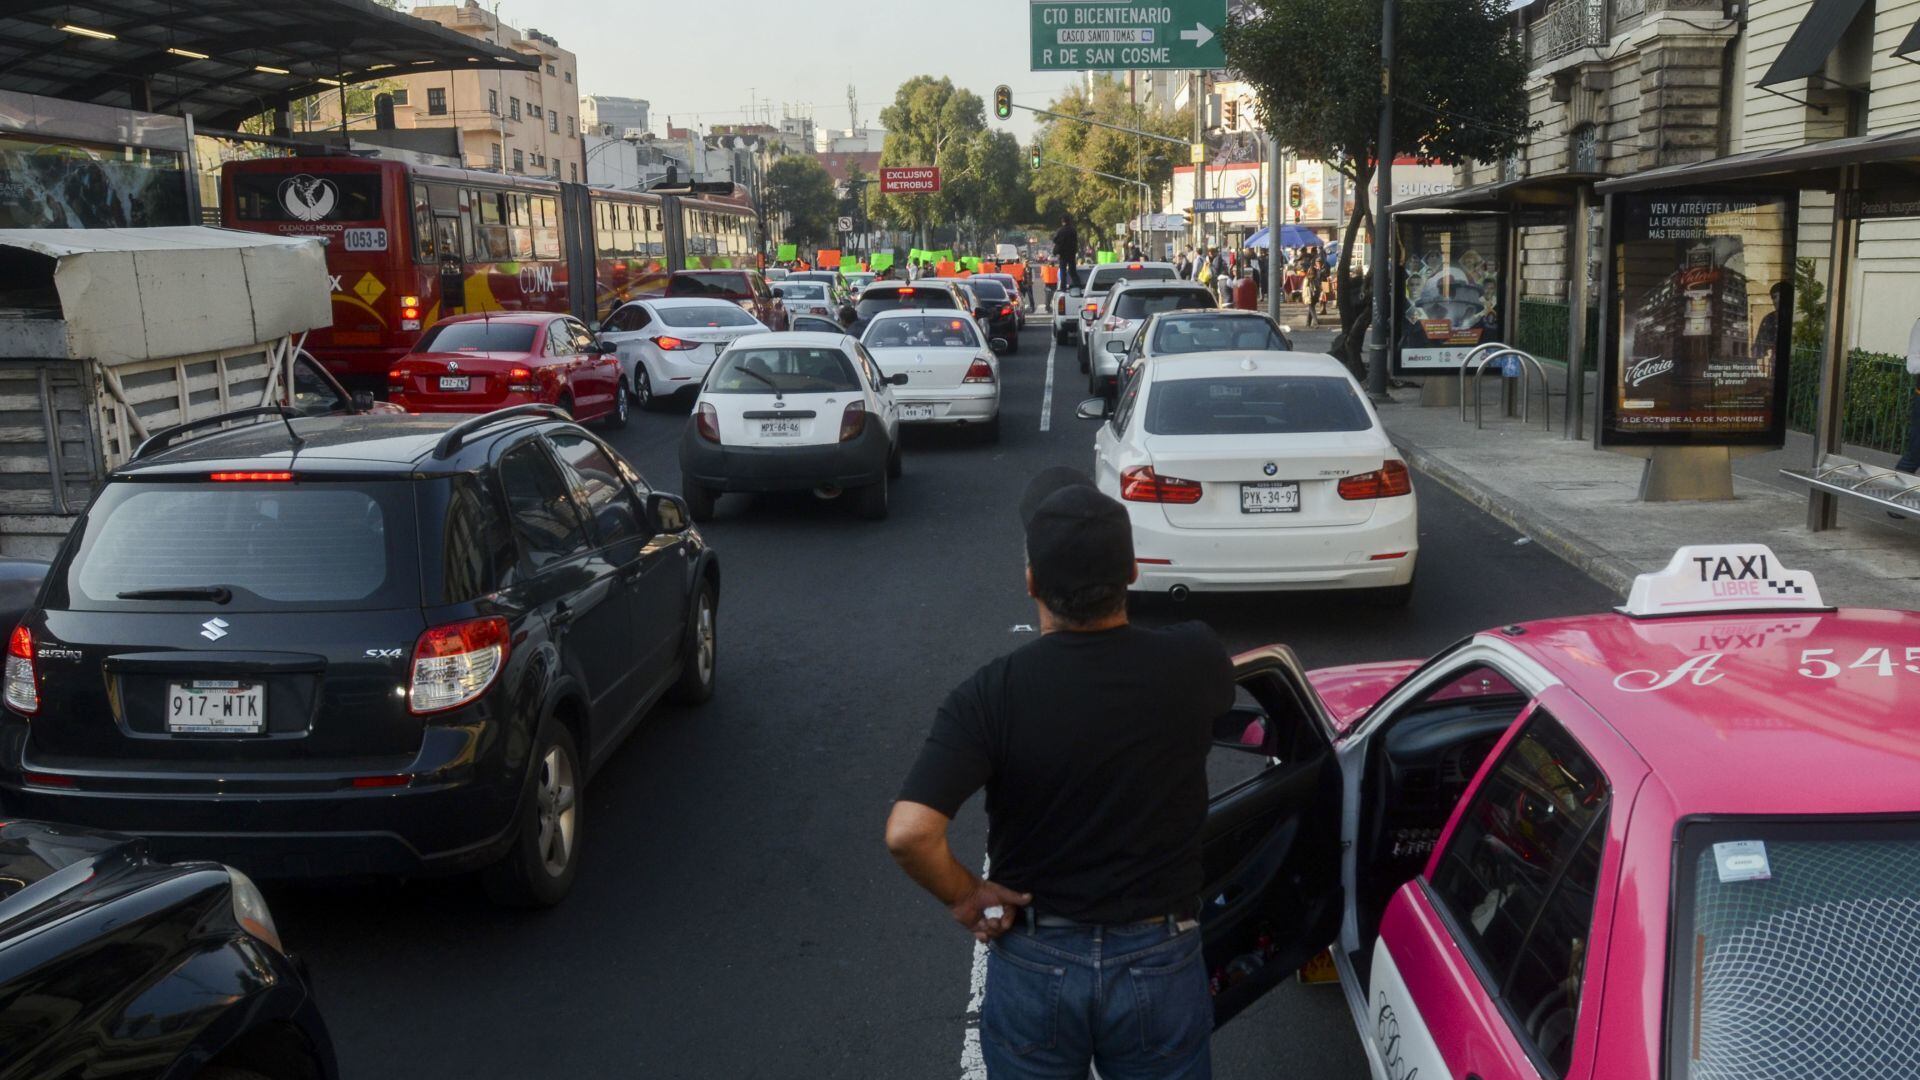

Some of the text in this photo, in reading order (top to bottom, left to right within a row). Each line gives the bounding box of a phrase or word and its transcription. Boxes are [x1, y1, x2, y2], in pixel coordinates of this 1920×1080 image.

[1043, 7, 1171, 25] CTO BICENTENARIO
[1062, 30, 1136, 42] CASCO SANTO TOMAS
[1043, 48, 1171, 65] R DE SAN COSME
[886, 170, 933, 179] EXCLUSIVO
[886, 181, 933, 190] METROBUS
[1651, 203, 1668, 214] VEN
[1671, 203, 1677, 214] Y
[1649, 217, 1659, 226] LA
[345, 231, 386, 248] 1053-B
[520, 266, 554, 294] CDMX
[1625, 354, 1674, 387] Victoria
[1243, 490, 1298, 505] PYK-34-97
[1693, 555, 1768, 582] TAXI
[1712, 580, 1760, 597] LIBRE
[365, 648, 403, 659] SX4
[173, 695, 257, 717] 917-WTK
